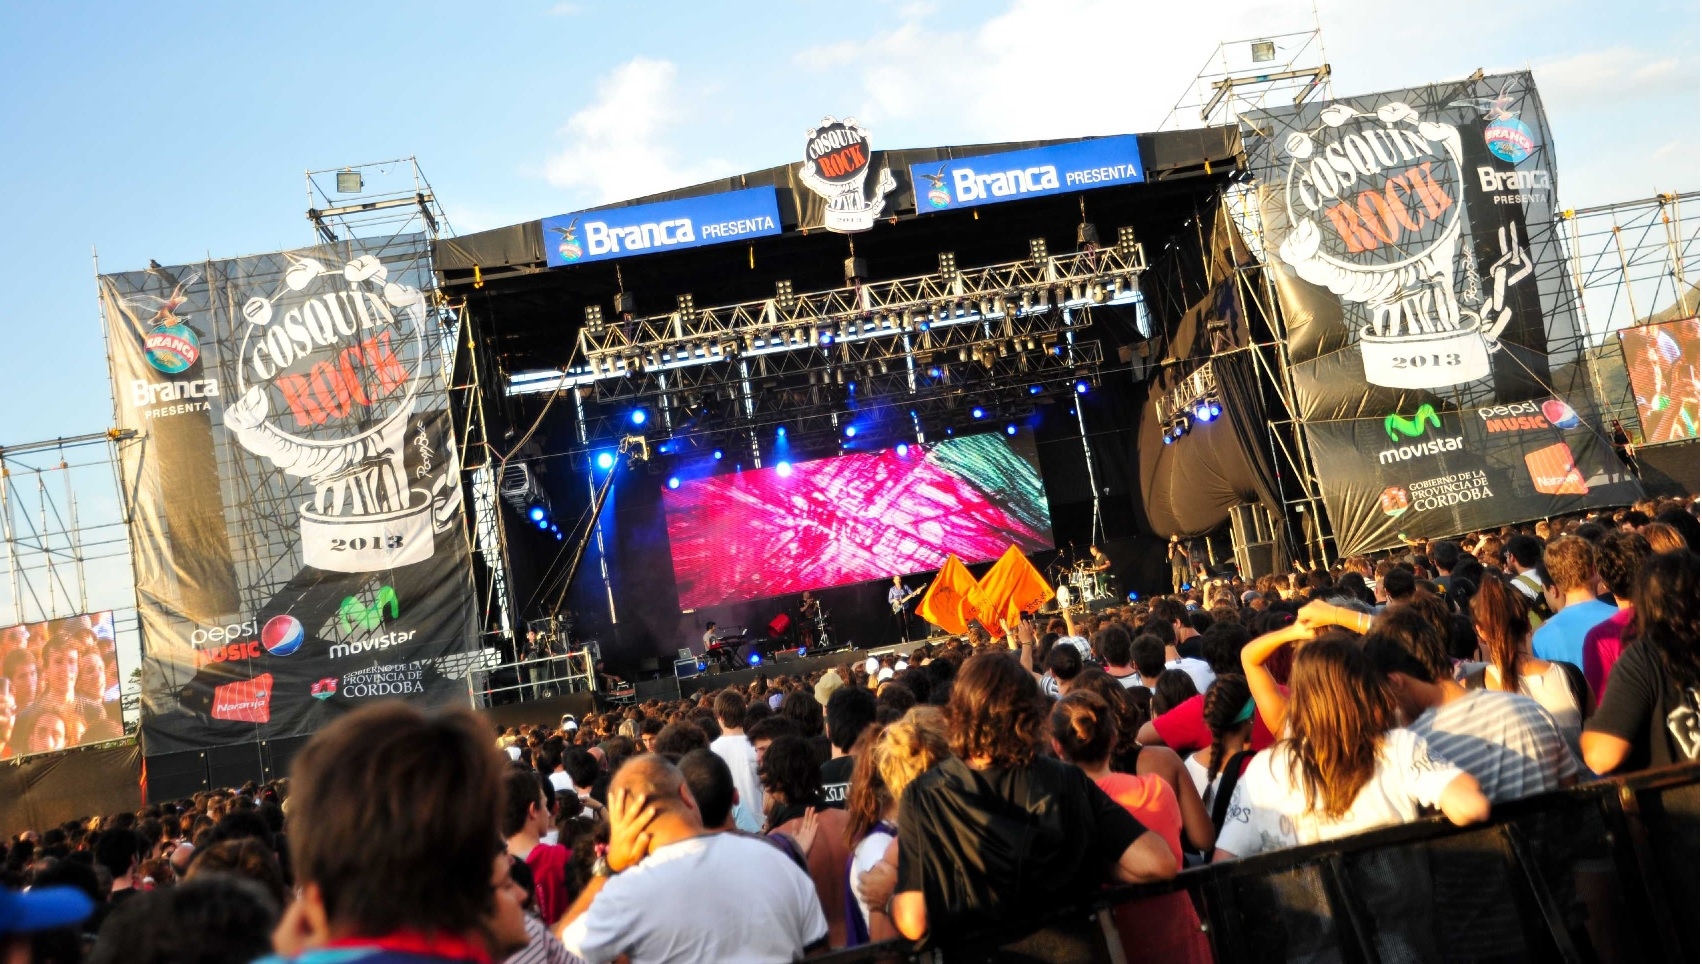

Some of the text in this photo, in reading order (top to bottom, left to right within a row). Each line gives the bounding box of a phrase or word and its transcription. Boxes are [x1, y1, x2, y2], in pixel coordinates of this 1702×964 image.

[1487, 129, 1531, 152] BRANCA
[818, 144, 866, 177] ROCK
[952, 165, 1060, 202] Branca
[1066, 164, 1137, 186] PRESENTA
[1477, 166, 1551, 192] Branca
[1325, 161, 1453, 253] ROCK
[1493, 193, 1547, 205] PRESENTA
[584, 217, 695, 256] Branca
[702, 216, 775, 240] PRESENTA
[146, 336, 195, 362] BRANCA
[1392, 353, 1462, 368] 2013
[276, 330, 410, 426] ROCK
[132, 378, 219, 407] Branca
[145, 401, 211, 420] PRESENTA
[1478, 400, 1540, 420] pepsi
[1485, 415, 1549, 433] MUSIC
[1379, 437, 1463, 465] movistar
[1409, 469, 1486, 491] GOBIERNO DE LA
[1411, 477, 1489, 500] PROVINCIA DE
[330, 535, 404, 552] 2013
[191, 616, 258, 649] pepsi
[329, 628, 416, 659] movistar
[193, 640, 261, 670] MUSIC
[343, 663, 422, 679] GOBIERNO DE LA
[343, 671, 423, 685] PROVINCIA DE
[217, 700, 265, 712] Naranja
